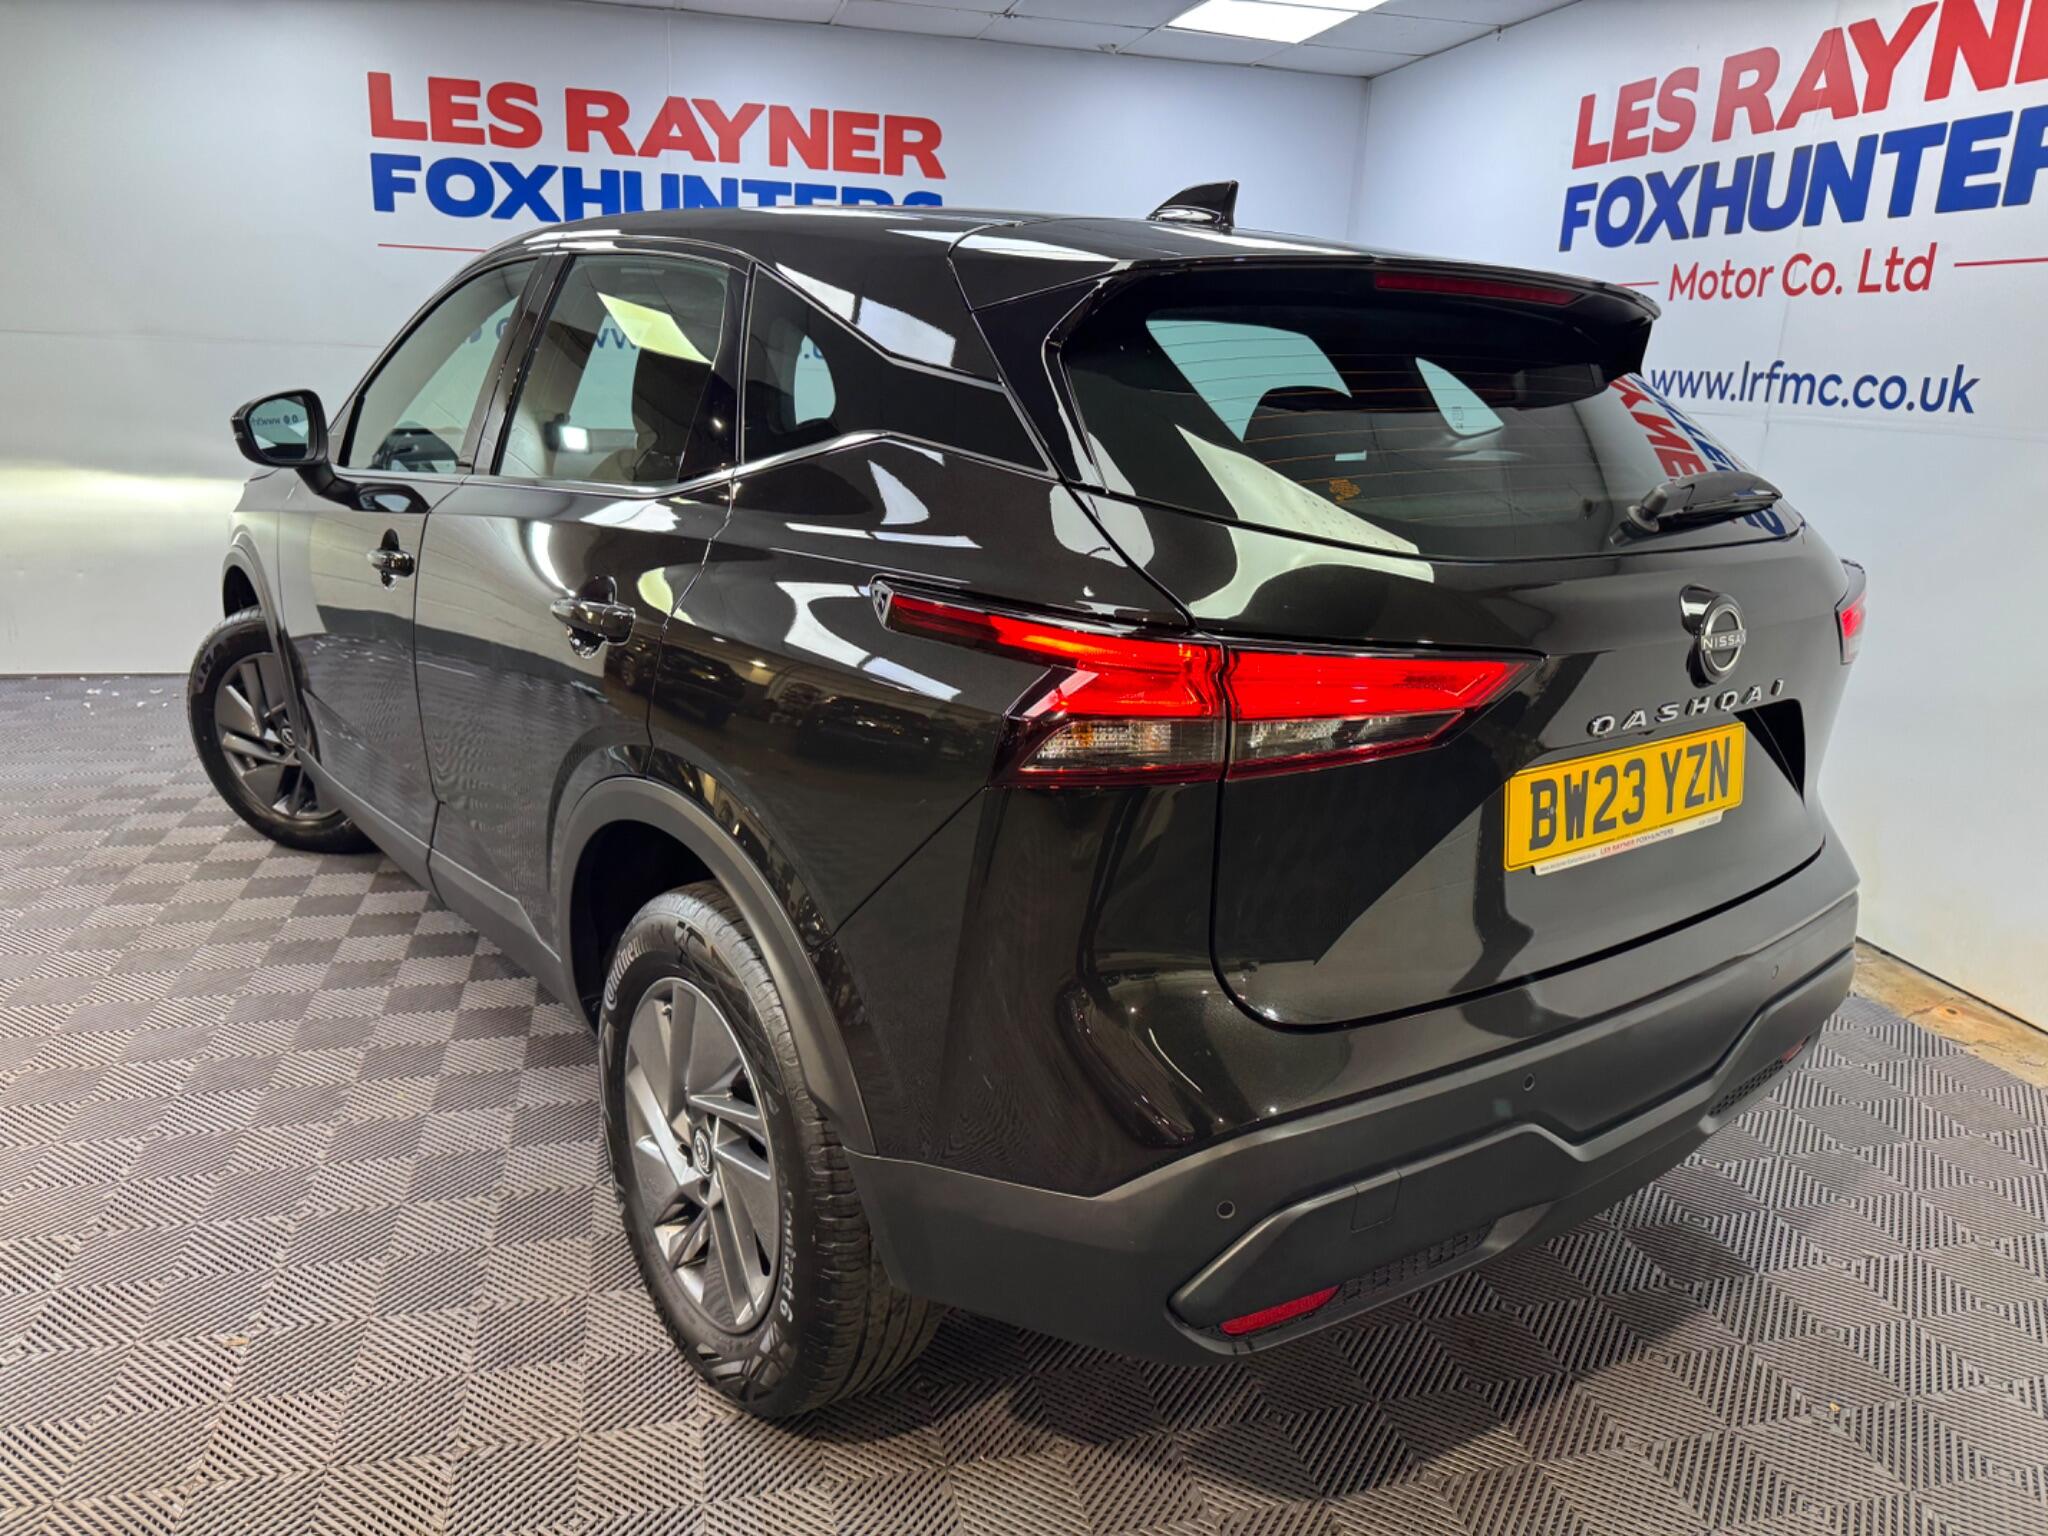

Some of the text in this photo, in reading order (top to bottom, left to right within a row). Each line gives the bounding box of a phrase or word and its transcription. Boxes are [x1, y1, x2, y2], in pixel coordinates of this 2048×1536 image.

[367, 71, 946, 179] LES RAYNER
[1571, 66, 1700, 170] LES
[1668, 241, 1938, 302] Motor Co. Ltd
[1651, 360, 1981, 415] www.lrfmc.co.uk
[1588, 678, 1784, 737] QASHQAI
[1528, 736, 1732, 852] BW23 YZN
